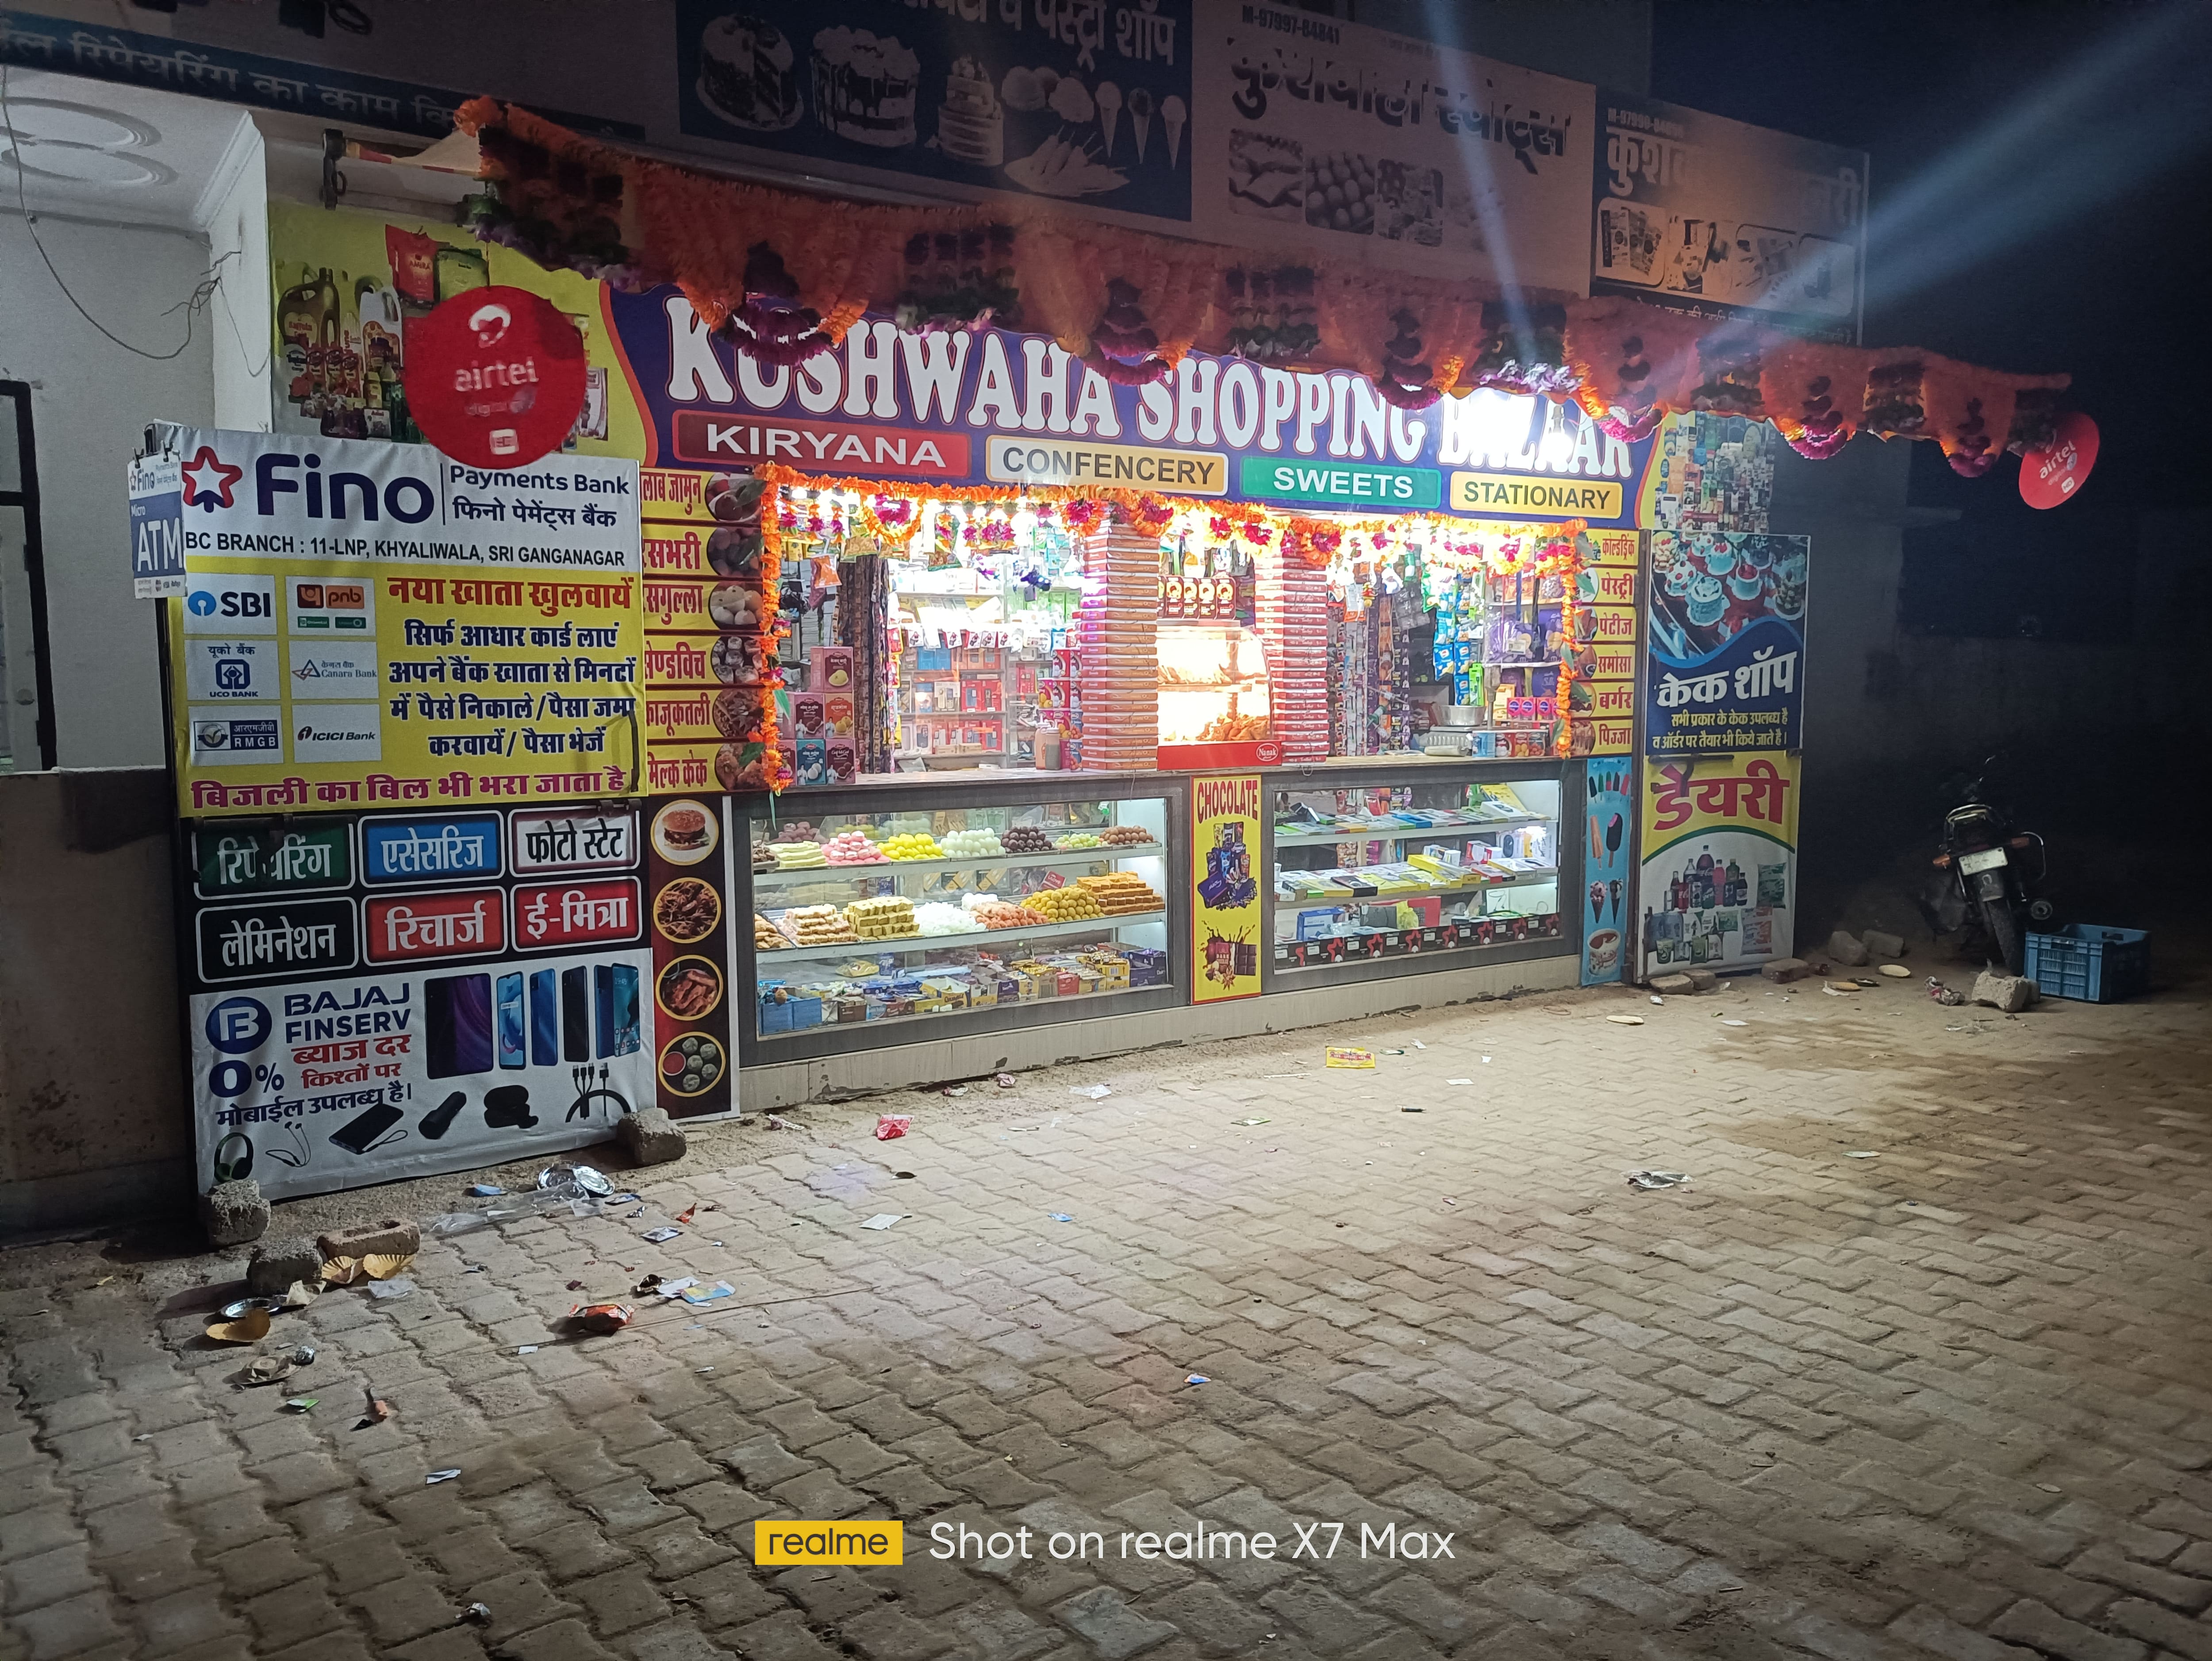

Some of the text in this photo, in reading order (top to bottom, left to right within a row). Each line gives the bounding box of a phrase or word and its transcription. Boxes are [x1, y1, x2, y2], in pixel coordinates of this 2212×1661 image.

[248, 71, 307, 103] का
[320, 81, 399, 120] काम
[455, 357, 539, 391] airtel
[708, 423, 946, 468] KIRYANA
[2039, 440, 2076, 479] airtel
[450, 465, 630, 495] Payments Bank
[1002, 447, 1214, 485] CONFENCERY
[1273, 466, 1414, 499] SWEETS
[256, 453, 434, 524] Fino
[641, 472, 701, 515] लाब जामुन
[1463, 481, 1611, 510] STATIONARY
[453, 495, 617, 531] फिनो पेमेंट्स बैंक
[138, 517, 182, 572] ATM
[186, 532, 211, 549] BC
[217, 534, 294, 553] BRANCH
[310, 537, 370, 558] 11-LNP,
[375, 540, 484, 564] KHYALIWALA,
[488, 545, 514, 562] SRI
[518, 547, 625, 566] GANGANAGAR
[328, 588, 361, 607] pnb
[387, 576, 634, 617] नया खाता खुलवायें
[1601, 572, 1633, 600] पेस्ट्री
[221, 592, 271, 617] SBI
[643, 584, 703, 625] सगुल्ला
[207, 642, 256, 658] यूको बैंक
[404, 619, 619, 648] सिर्फ आधार कार्ड लाएं
[389, 655, 636, 684] अपने बैंक खाता से मिनटों
[1598, 650, 1632, 673] समोसा
[1656, 645, 1797, 707] केक शॉप
[390, 692, 411, 720] में
[416, 692, 455, 720] पैसे
[459, 692, 534, 719] निकाले
[1599, 686, 1633, 709] बर्गर
[1671, 709, 1690, 727] सभी
[1690, 713, 1715, 727] प्रकार
[1717, 709, 1727, 726] के
[1728, 708, 1748, 726] केक
[312, 731, 376, 741] ICICI Bank
[521, 727, 565, 754] पैसा
[568, 726, 607, 753] भेजें
[1685, 735, 1698, 748] पर
[1698, 730, 1722, 747] तैयार
[1722, 729, 1734, 746] भी
[682, 750, 708, 788] केक
[191, 765, 626, 809] बिजली का बिल भी भरा जाता है
[1197, 779, 1258, 824] CHOCOLATE
[381, 824, 484, 874] एसेसरिज
[526, 817, 623, 862] फोटो स्टेट
[384, 900, 486, 952] रिचार्ज
[524, 890, 629, 941] ई-मित्रा
[219, 916, 336, 968] लेमिनेशन
[284, 982, 410, 1017] BAJAJ
[284, 1008, 411, 1044] FINSERV
[291, 1034, 411, 1065] ब्याज दर
[301, 1062, 402, 1089] किश्तों पर
[215, 1096, 304, 1126] मोबाईल
[307, 1084, 384, 1114] उपलब्ध
